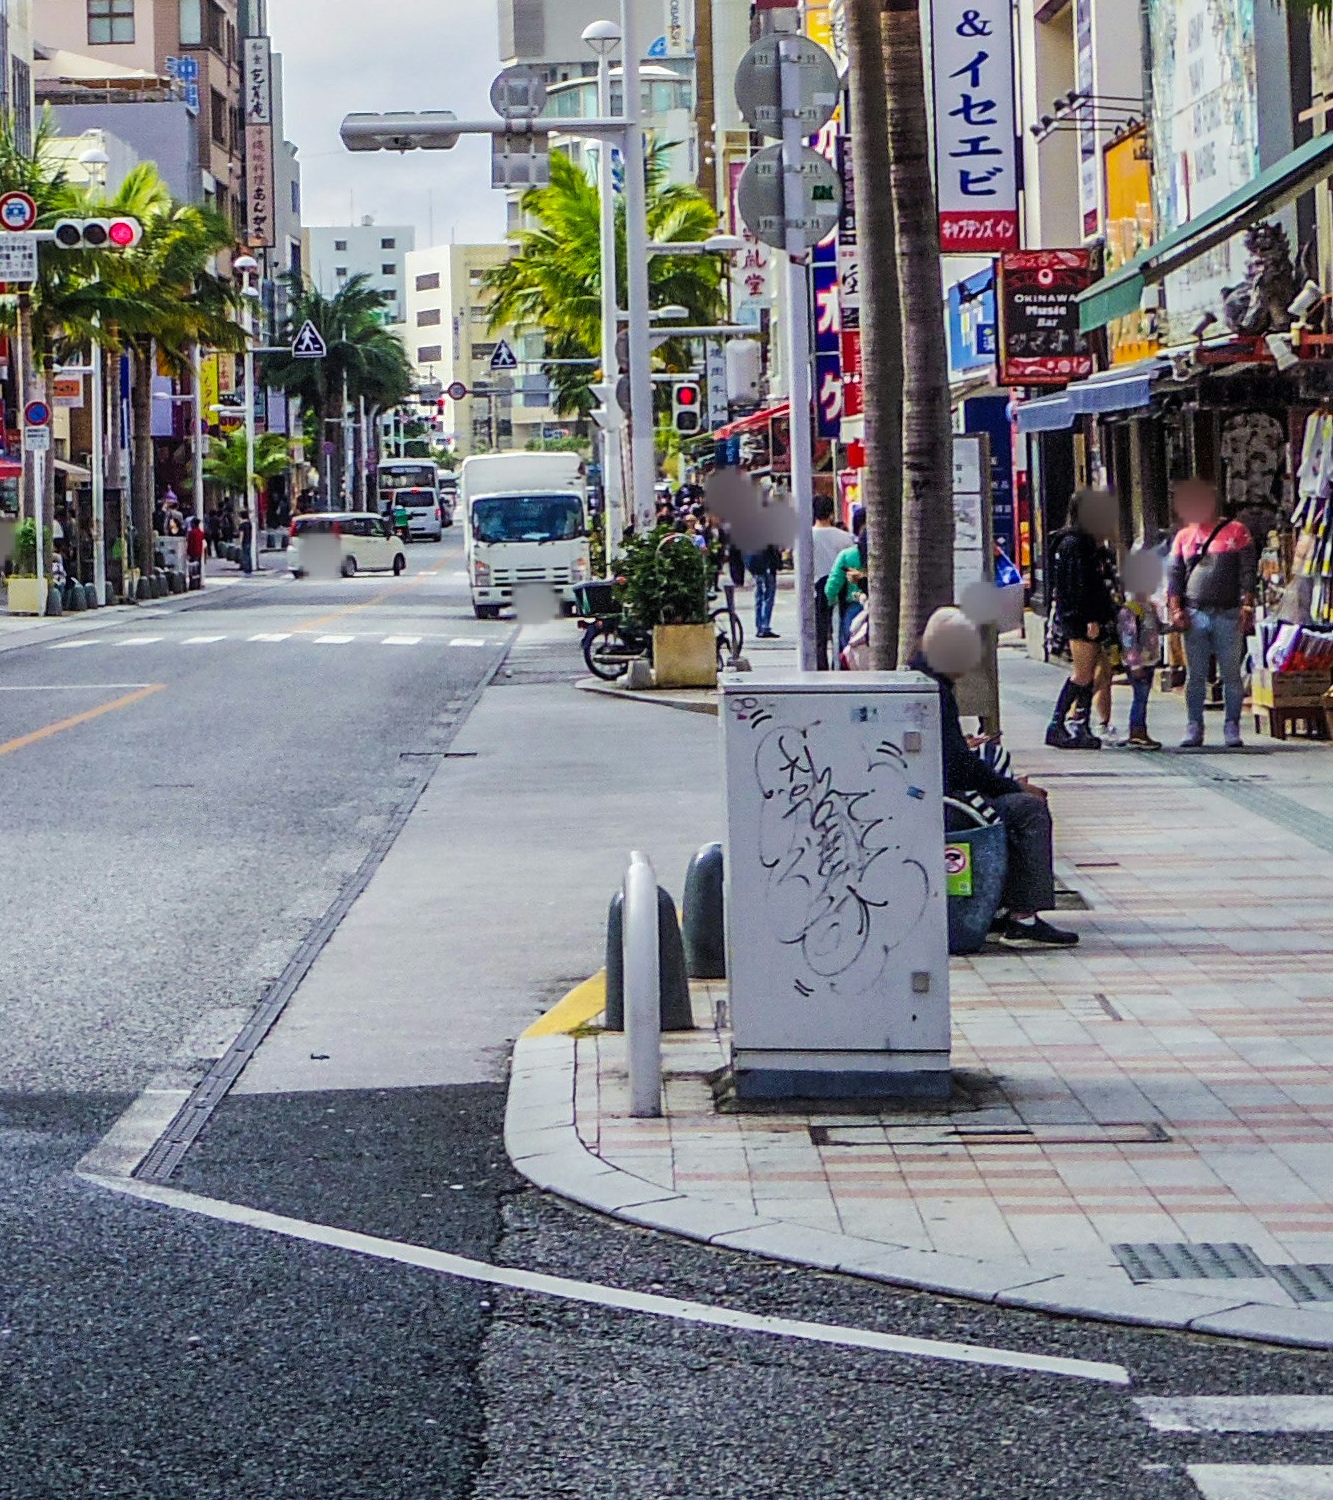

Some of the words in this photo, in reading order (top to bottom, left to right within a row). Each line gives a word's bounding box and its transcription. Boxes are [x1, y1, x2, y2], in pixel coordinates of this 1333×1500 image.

[1014, 293, 1079, 304] OKINAWA
[1025, 305, 1068, 316] Music
[1036, 317, 1059, 328] Bar
